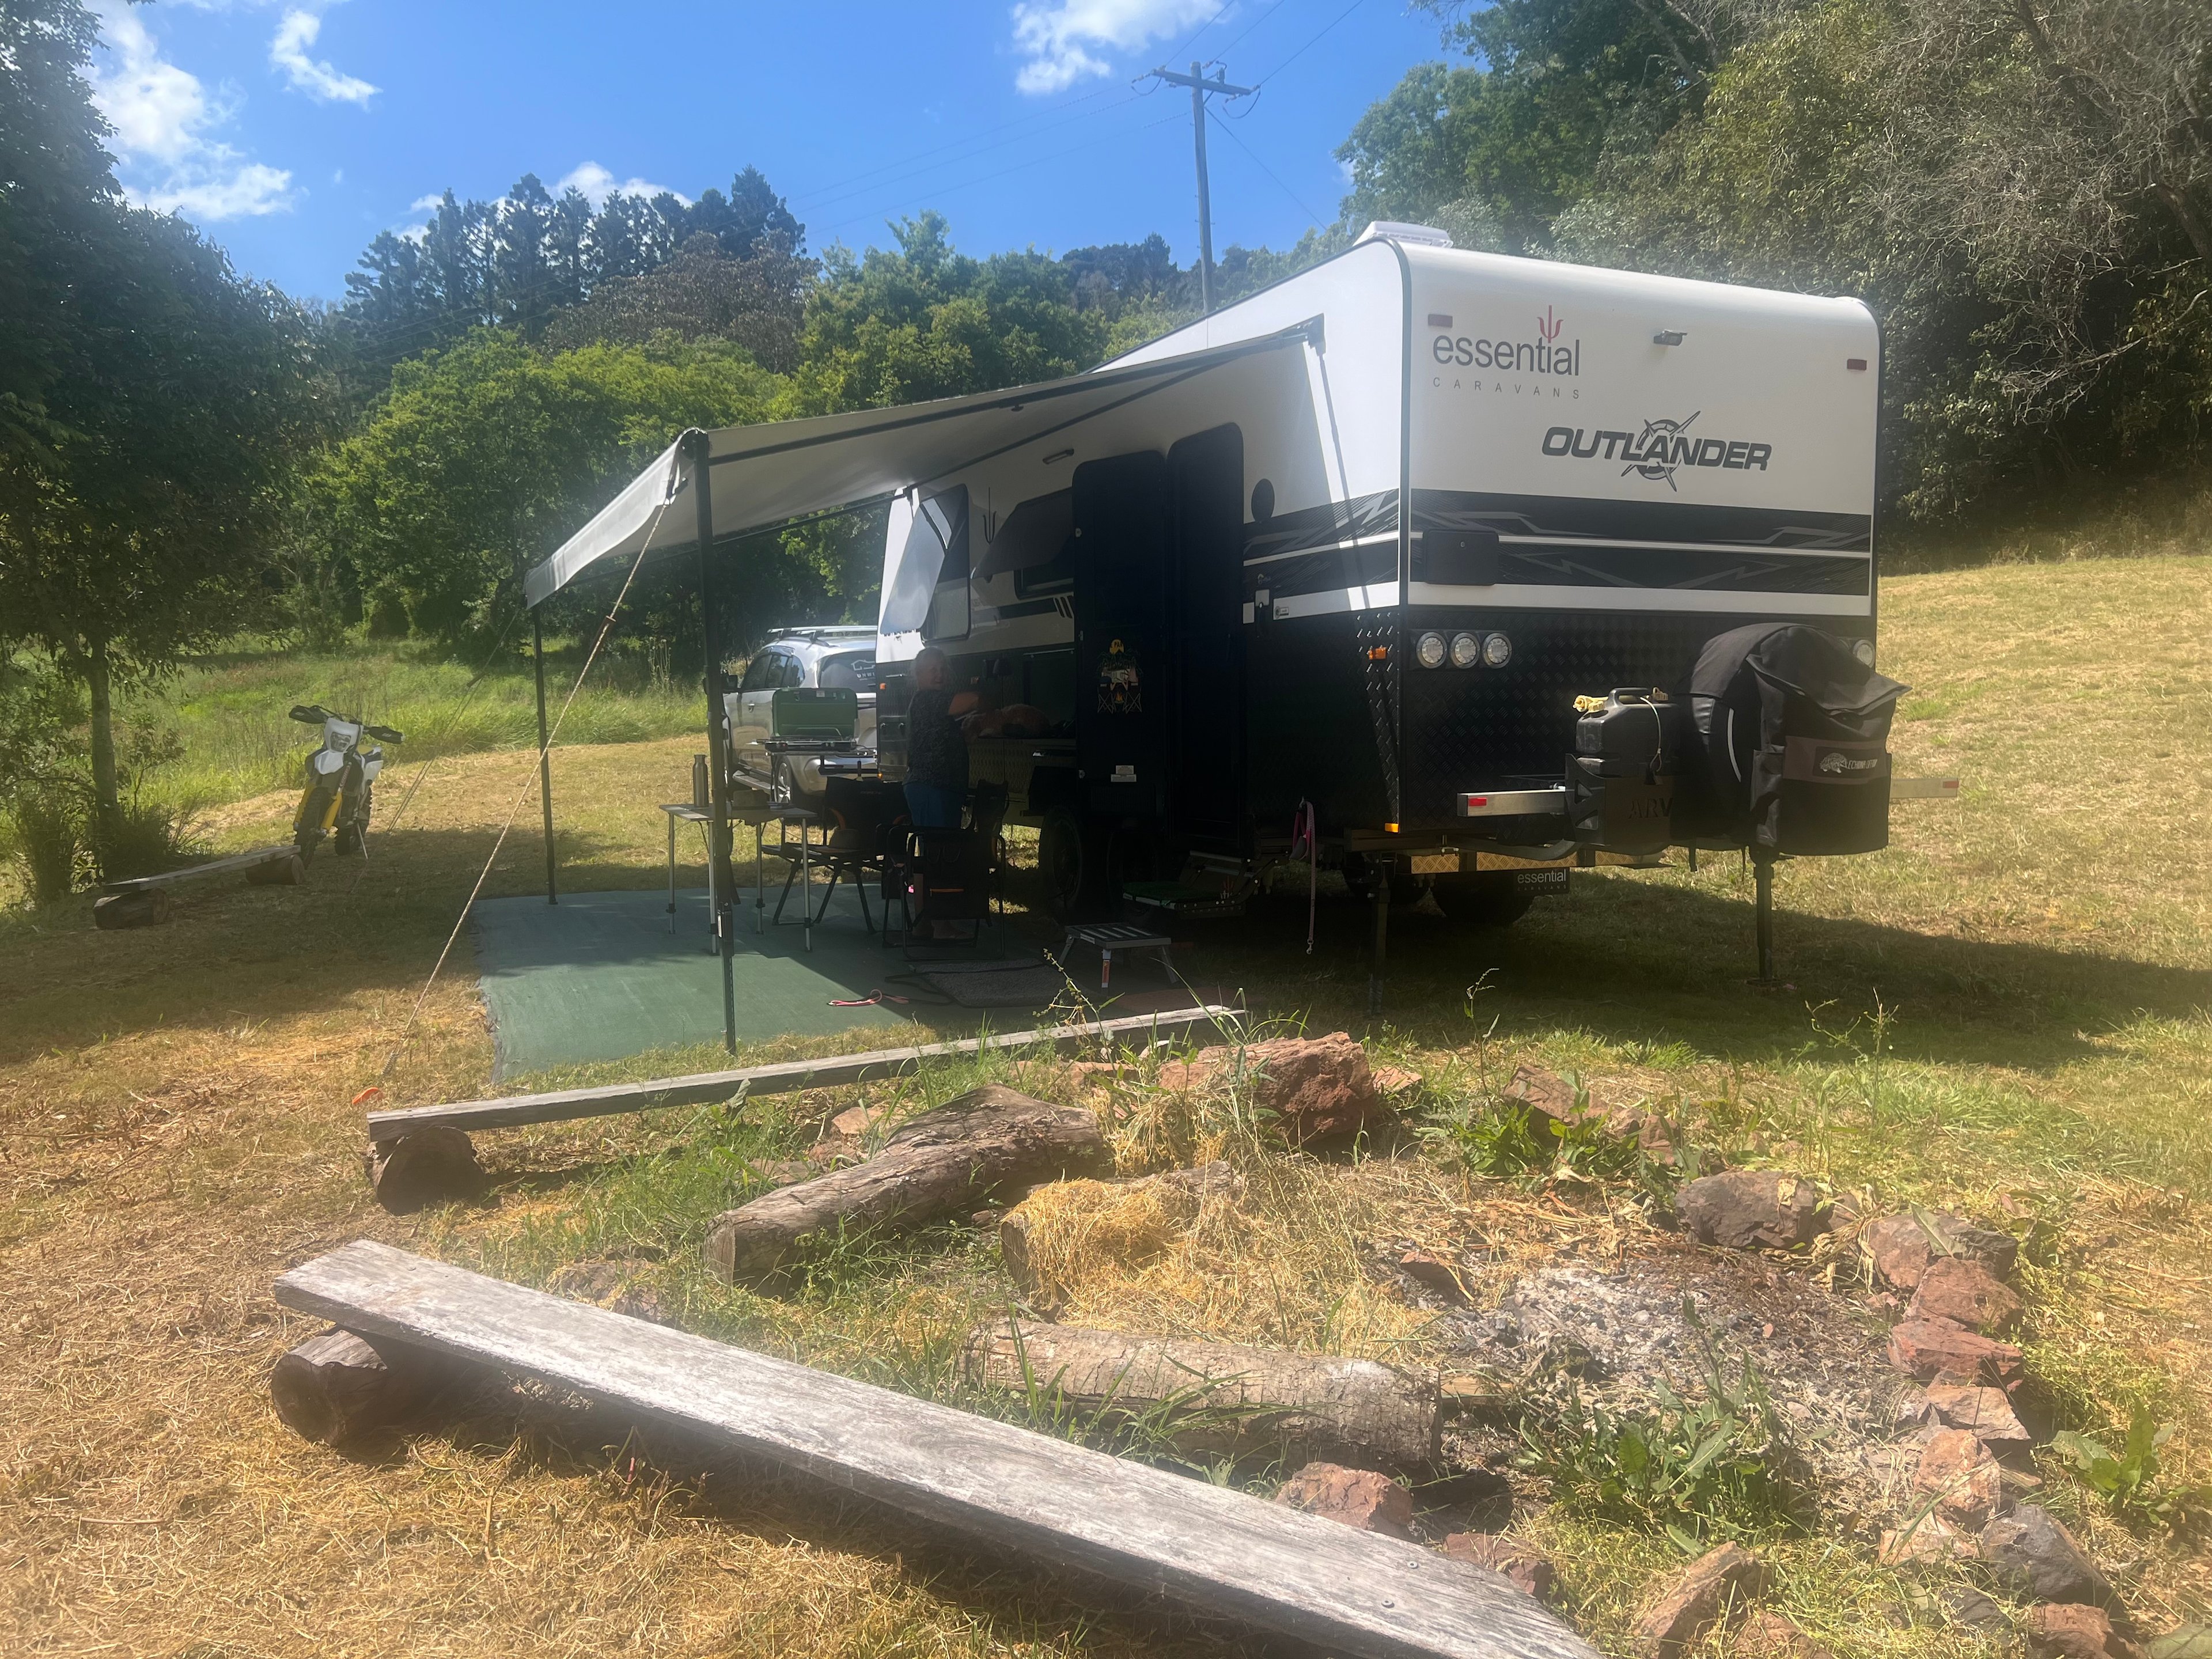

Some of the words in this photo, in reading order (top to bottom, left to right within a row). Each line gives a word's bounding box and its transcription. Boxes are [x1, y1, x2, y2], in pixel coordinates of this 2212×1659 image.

[1433, 334, 1580, 376] essential
[1433, 376, 1580, 399] CARAVANS
[1541, 426, 1772, 471] OUTLANDER
[1517, 869, 1566, 884] essential
